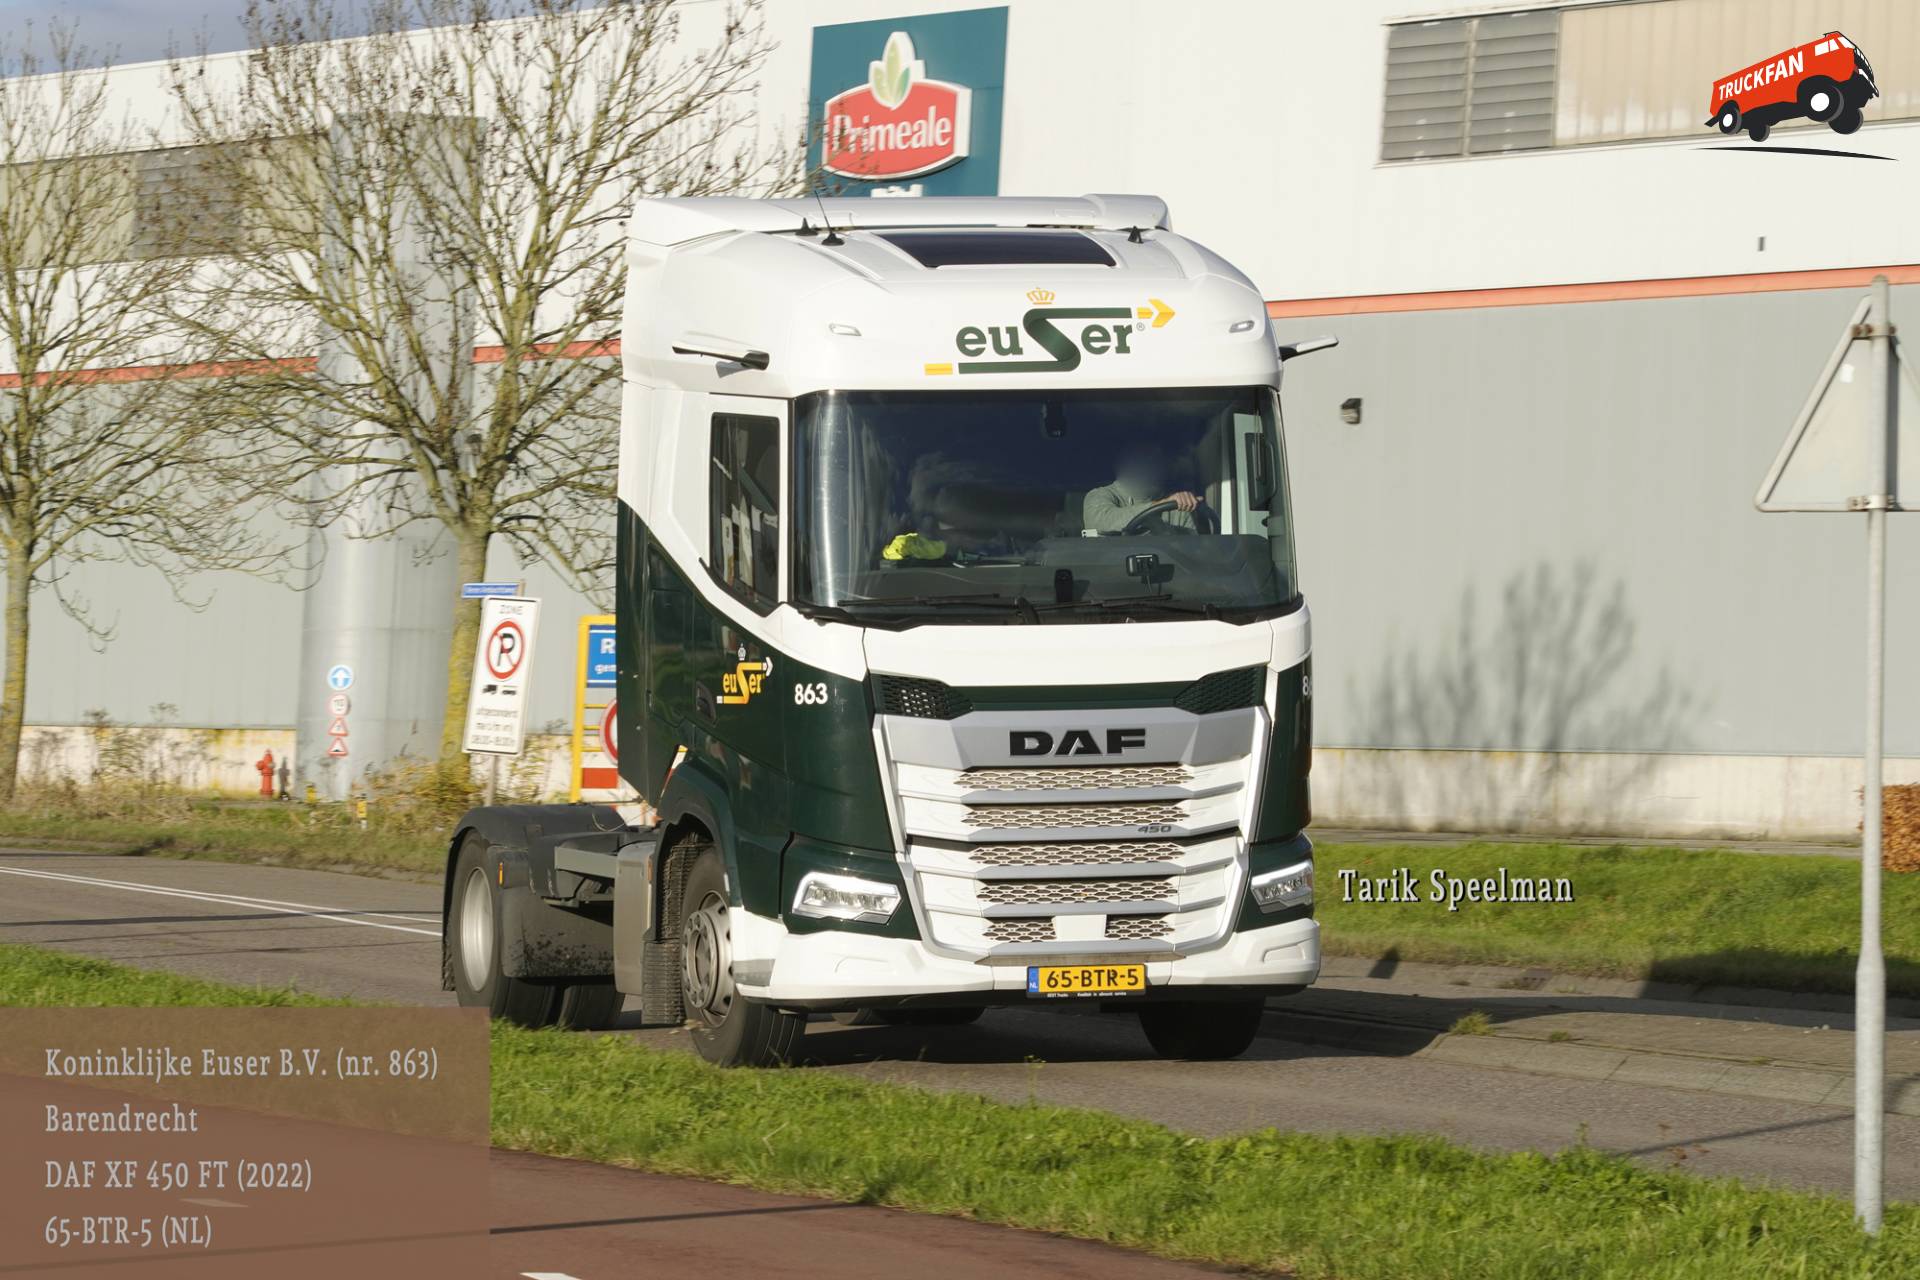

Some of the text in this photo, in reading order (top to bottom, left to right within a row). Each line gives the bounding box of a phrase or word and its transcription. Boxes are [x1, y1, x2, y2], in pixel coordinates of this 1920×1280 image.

[831, 105, 951, 155] Primeale
[794, 682, 828, 705] 863
[1009, 728, 1146, 757] DAF
[1137, 824, 1172, 834] 450
[1046, 968, 1139, 989] 65-BTR-5
